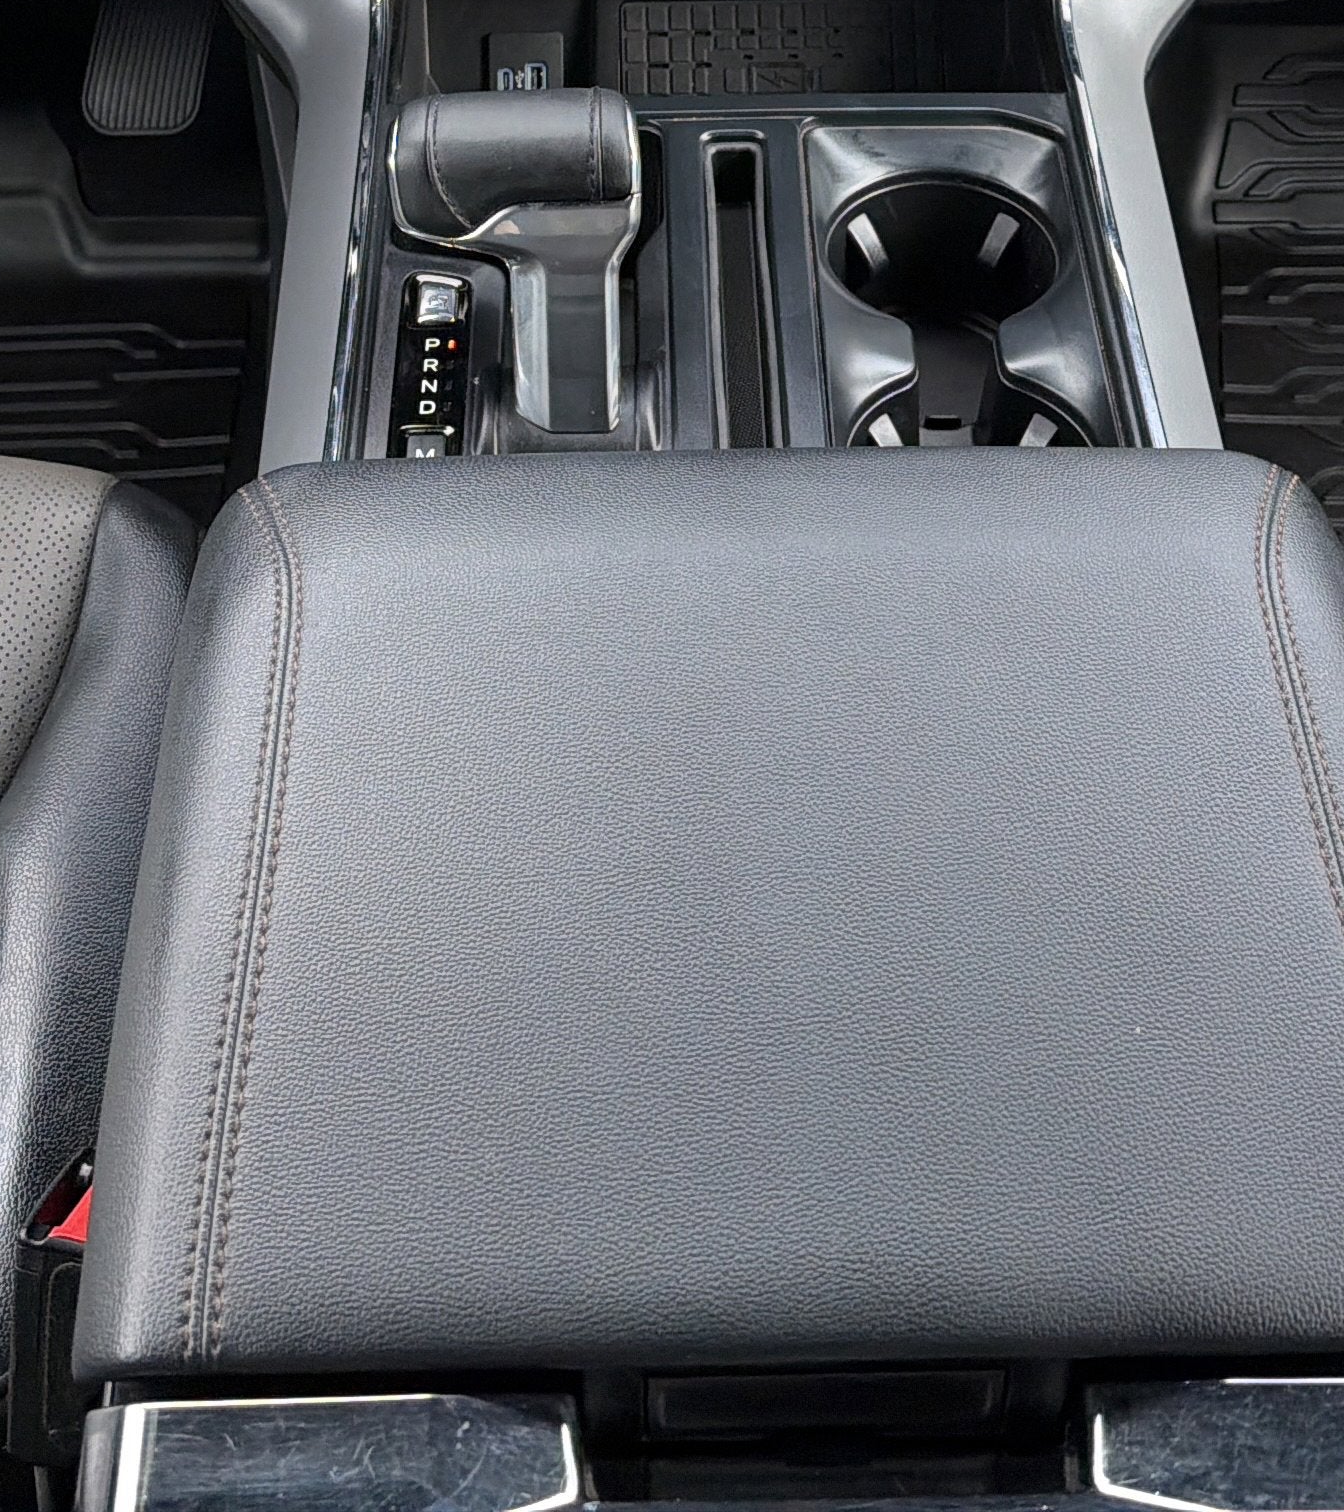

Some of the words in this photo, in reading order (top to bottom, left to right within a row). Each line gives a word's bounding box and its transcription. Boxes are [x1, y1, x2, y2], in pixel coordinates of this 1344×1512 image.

[425, 338, 440, 352] P
[423, 359, 439, 372] R
[421, 380, 438, 393] N
[419, 401, 437, 415] D
